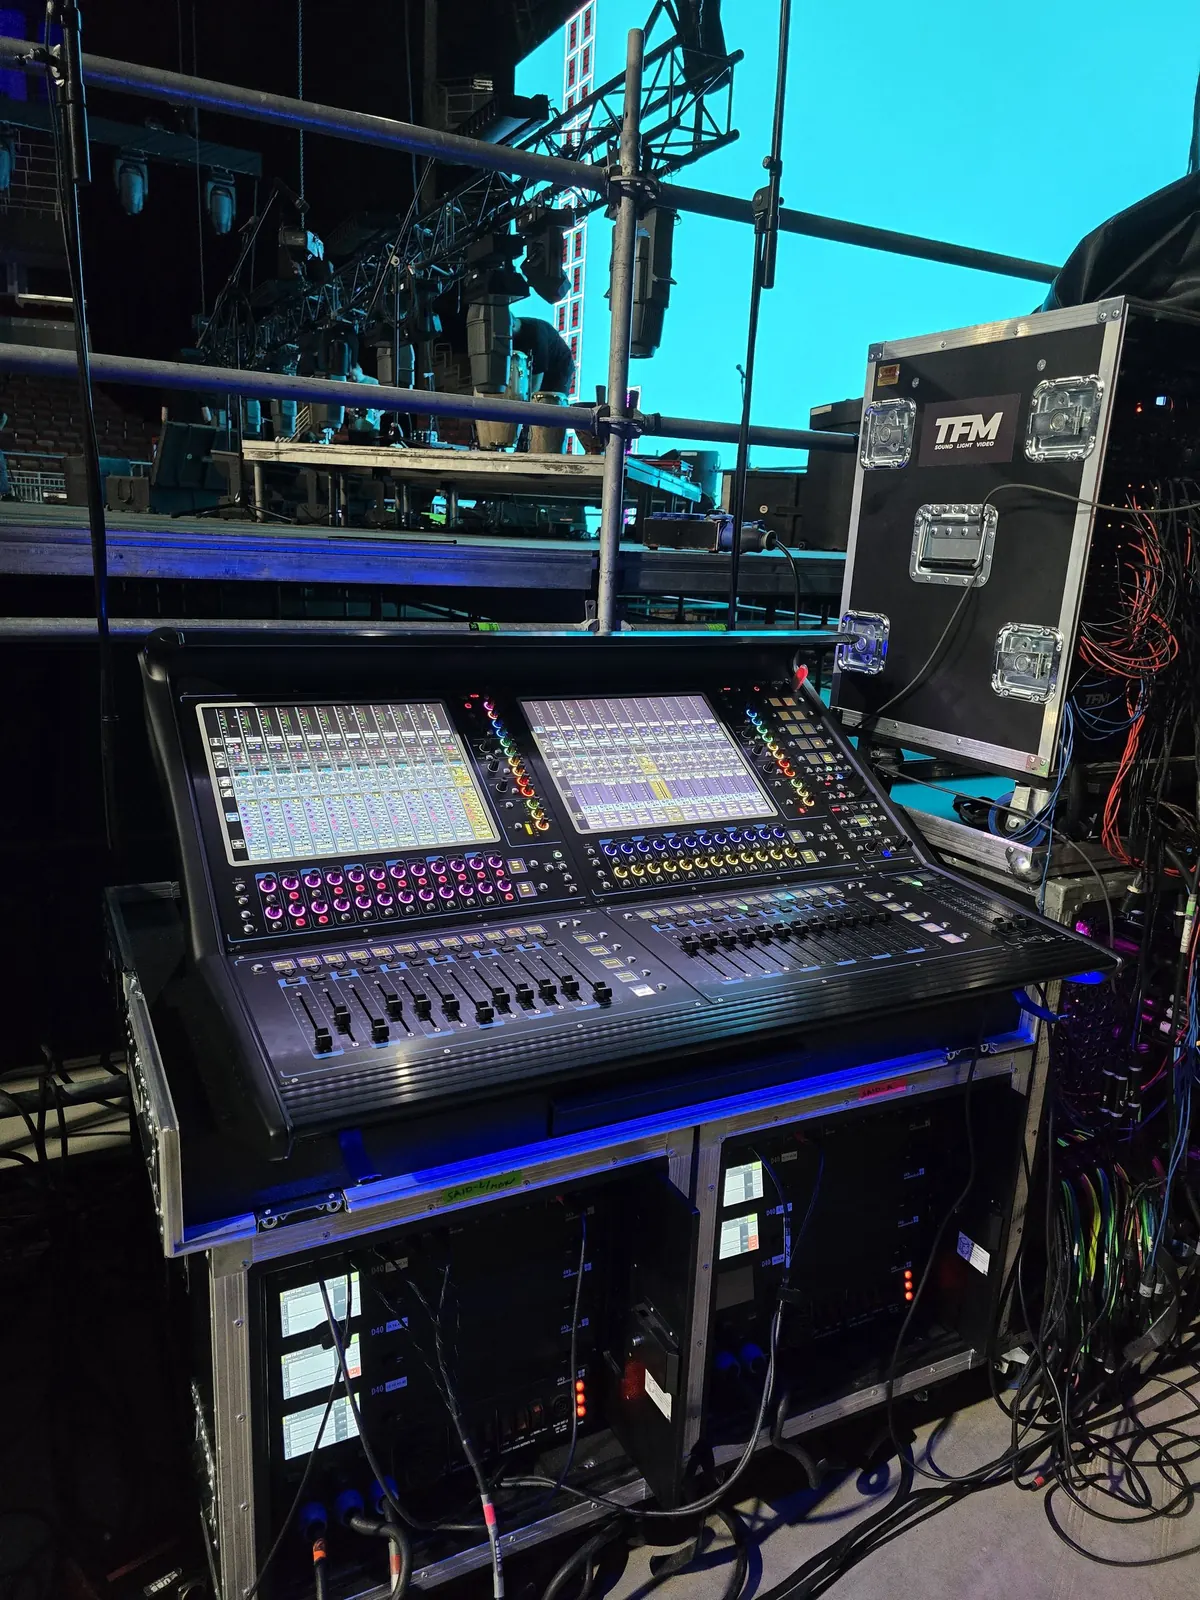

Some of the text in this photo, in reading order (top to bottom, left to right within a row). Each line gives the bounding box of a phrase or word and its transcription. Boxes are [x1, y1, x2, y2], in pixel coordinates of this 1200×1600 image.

[935, 412, 1003, 444] TFM
[976, 440, 994, 448] VIDEO
[370, 1325, 384, 1336] D40
[371, 1384, 384, 1396] D40
